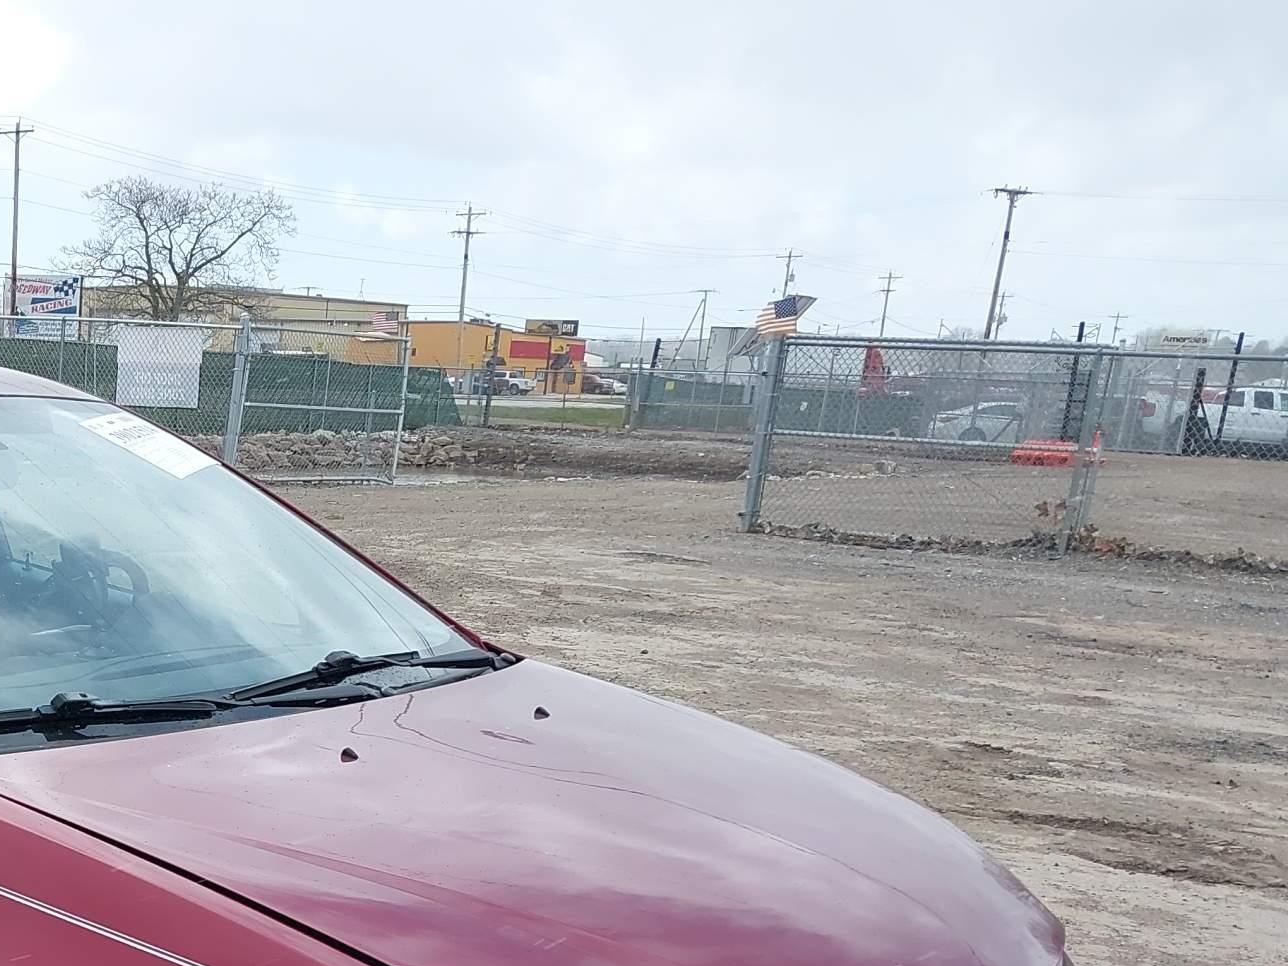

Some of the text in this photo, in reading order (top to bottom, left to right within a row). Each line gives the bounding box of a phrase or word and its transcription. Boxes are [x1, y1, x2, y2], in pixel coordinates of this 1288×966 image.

[9, 283, 52, 295] EEDWAY
[31, 299, 73, 314] RACING
[562, 323, 577, 333] CAT
